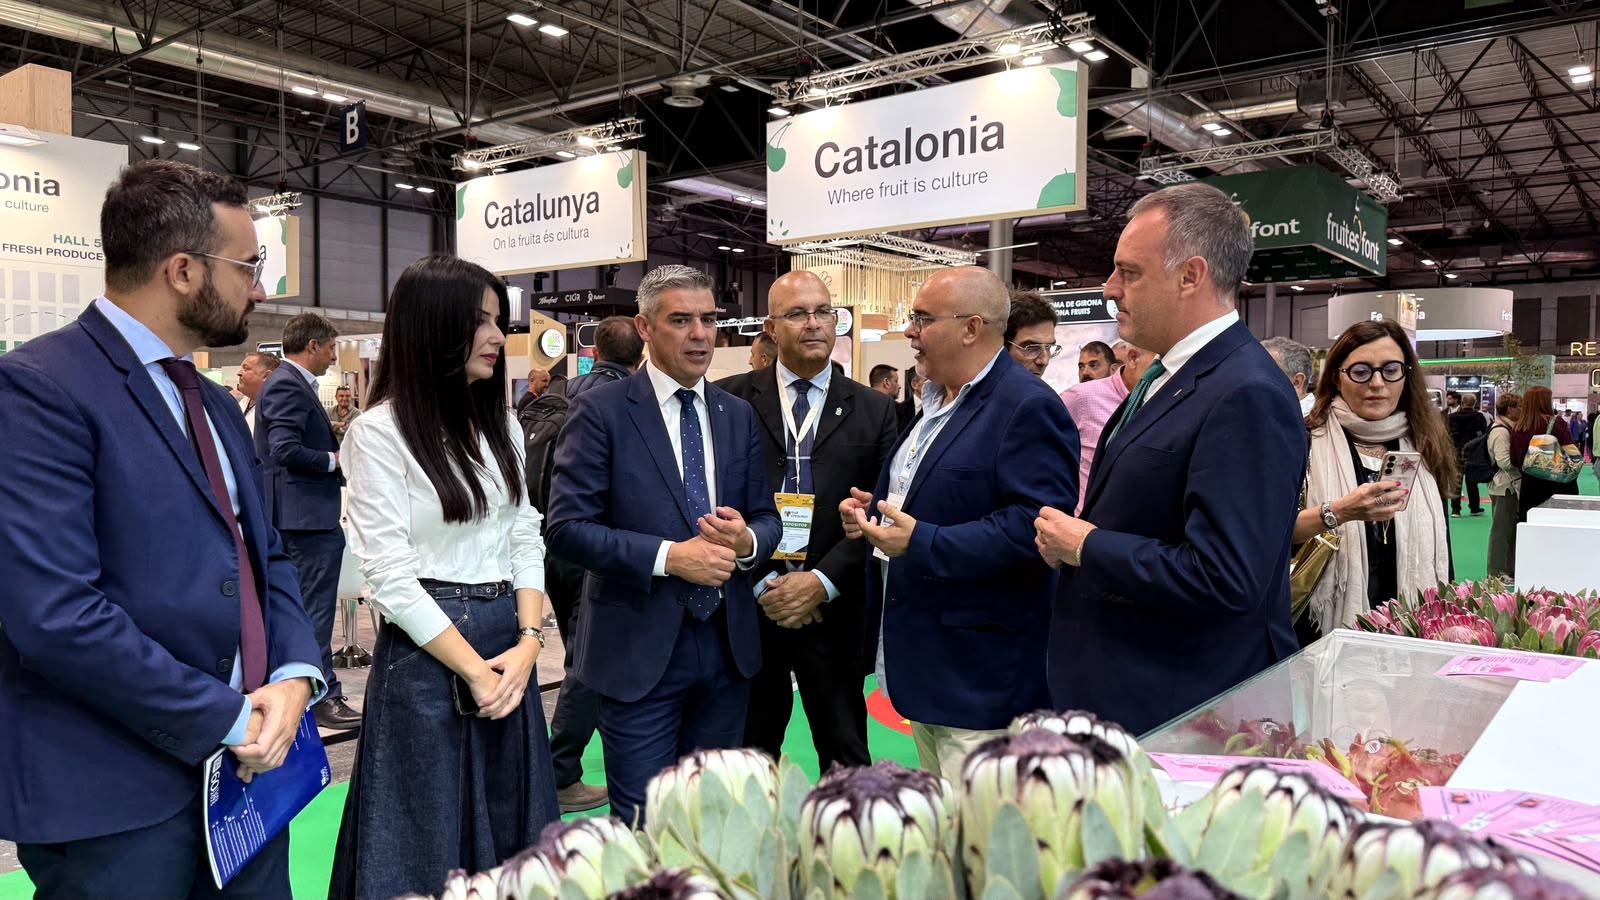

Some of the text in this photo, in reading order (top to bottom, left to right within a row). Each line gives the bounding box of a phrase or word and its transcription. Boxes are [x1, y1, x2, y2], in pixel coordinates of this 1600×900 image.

[346, 110, 359, 144] B
[814, 115, 1005, 179] Catalonia
[828, 170, 988, 205] Where fruit is culture
[5, 199, 49, 213] culture
[484, 191, 600, 229] Catalunya
[1250, 218, 1301, 238] font
[1326, 211, 1380, 265] fruites font
[53, 233, 102, 248] HALL 5
[493, 227, 590, 250] On la fruita és cultura
[2, 243, 104, 261] FRESH PRODUCE
[1070, 308, 1091, 316] FRUITS
[1075, 299, 1103, 307] GIRONA
[1570, 341, 1600, 356] RE
